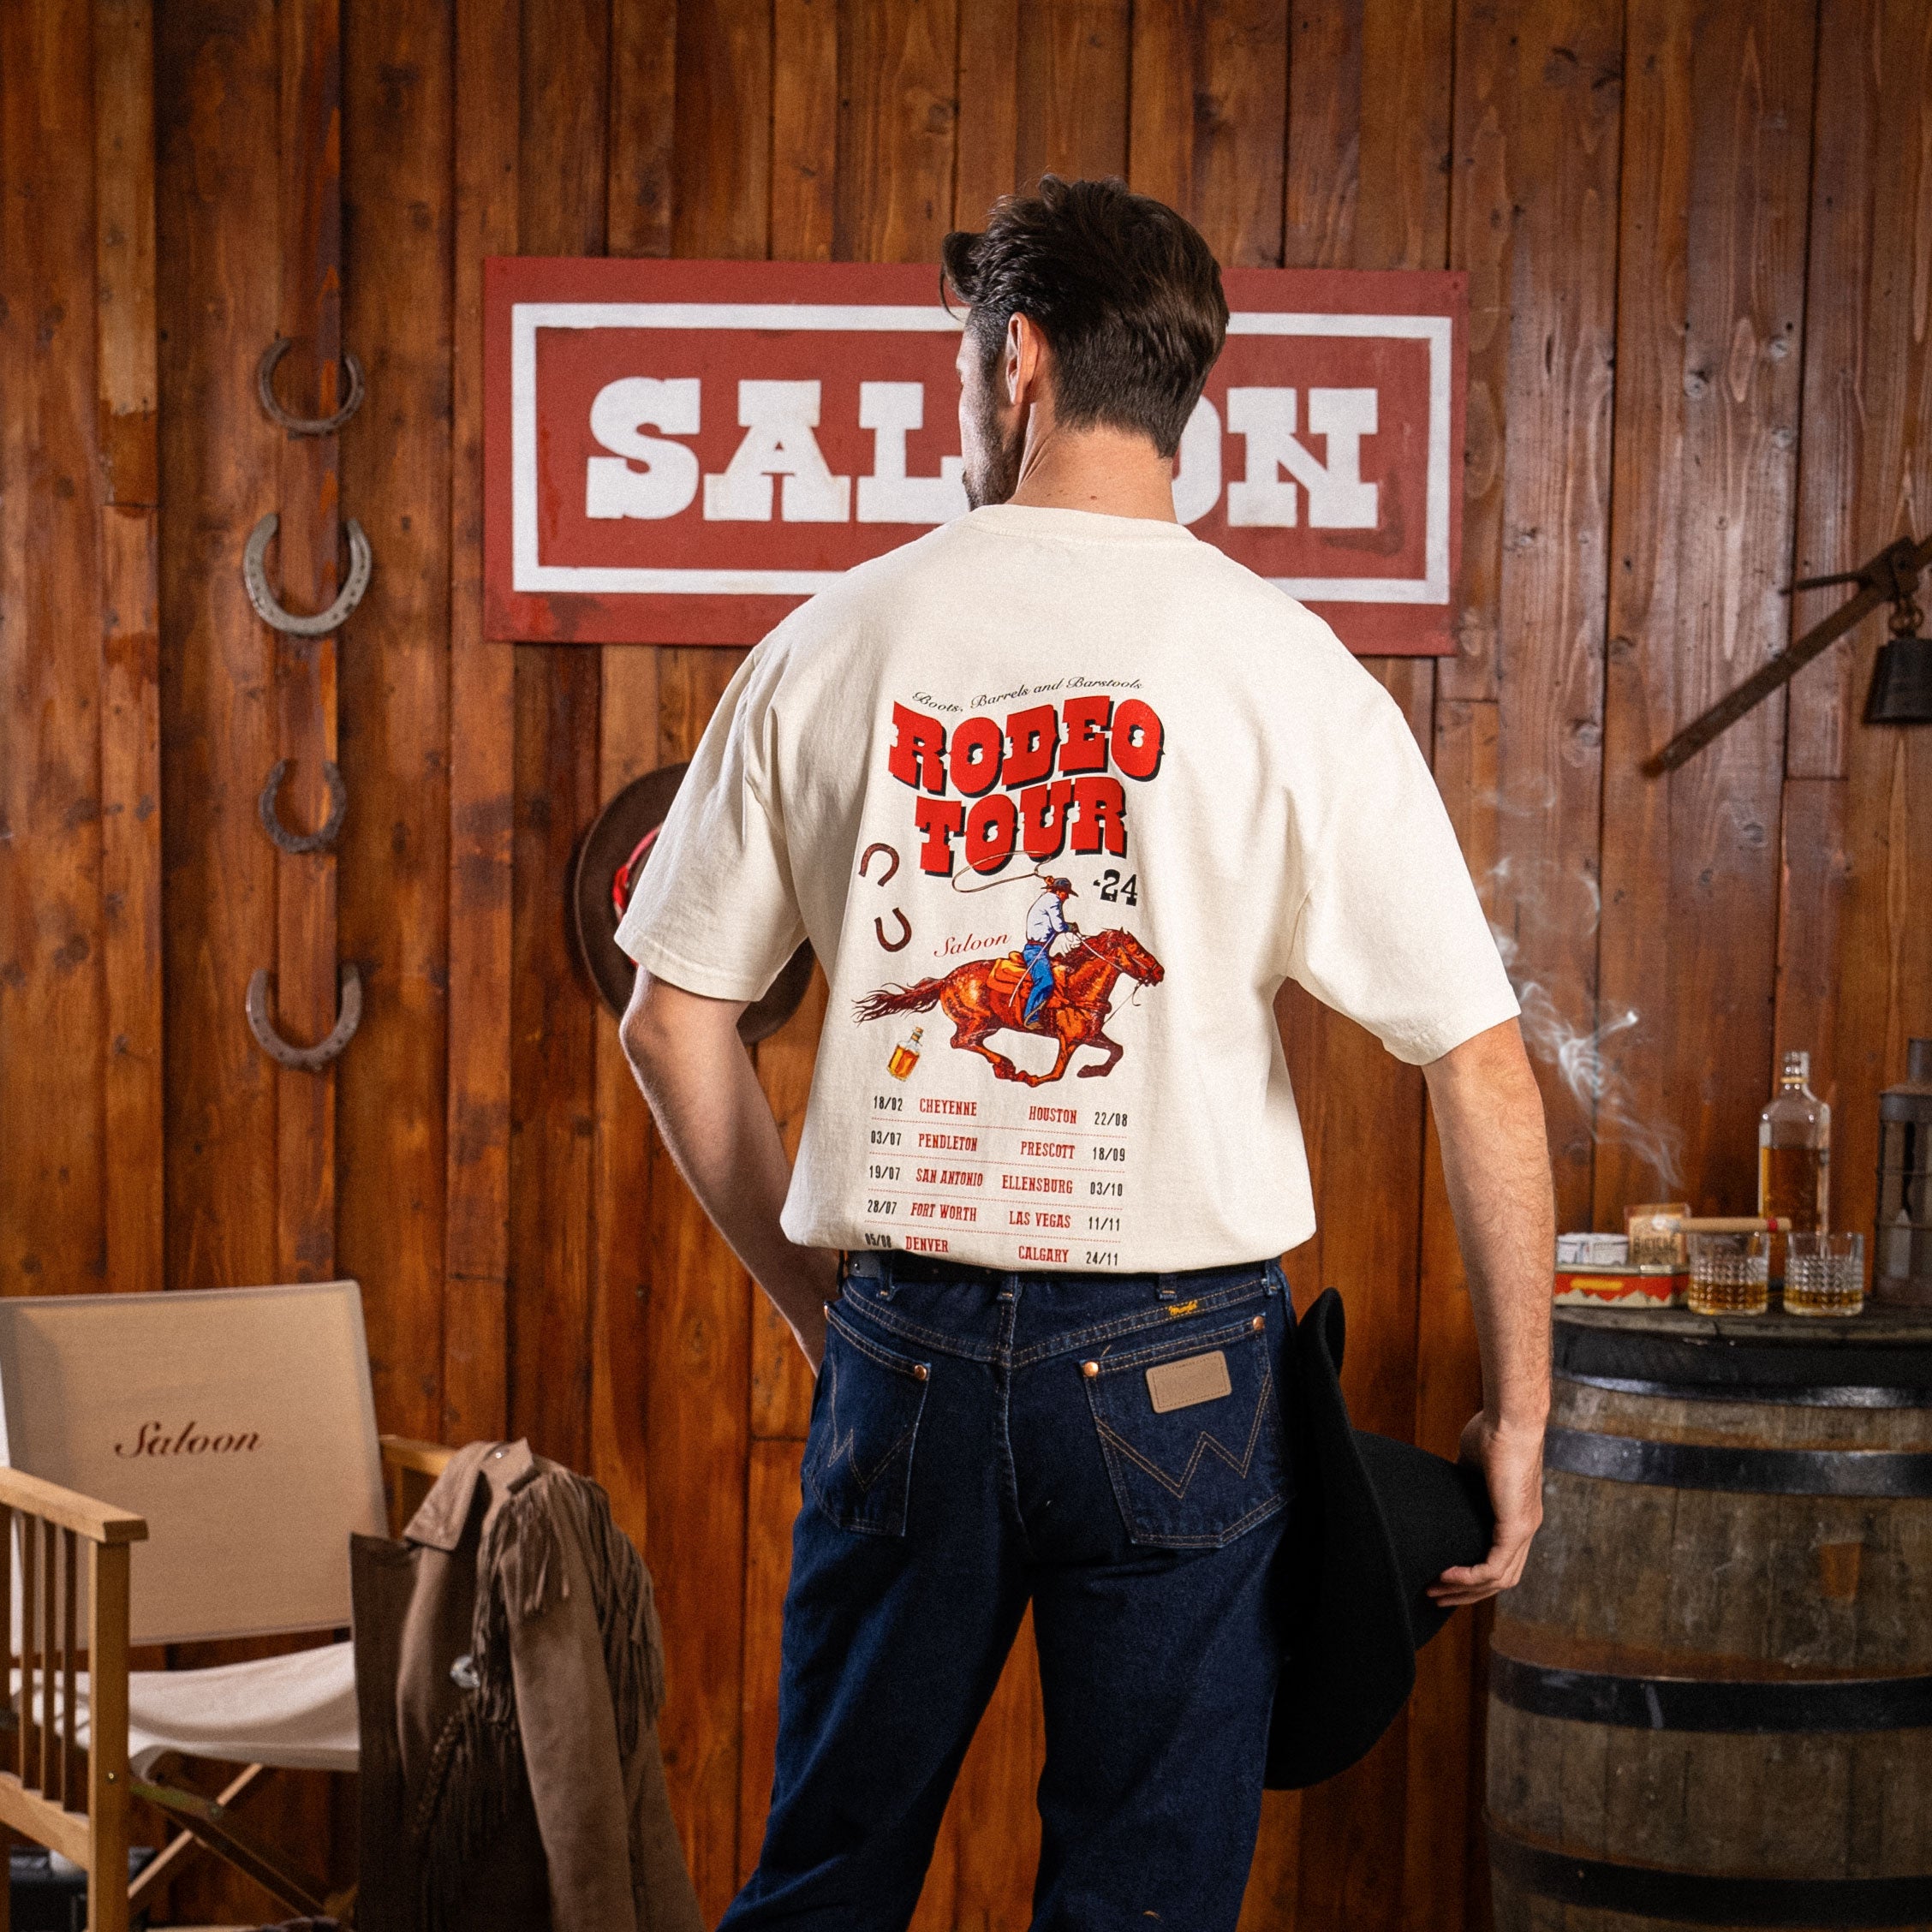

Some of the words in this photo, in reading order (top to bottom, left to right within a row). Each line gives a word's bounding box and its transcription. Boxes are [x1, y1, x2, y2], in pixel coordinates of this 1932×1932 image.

[586, 377, 1378, 528] SALN
[912, 691, 963, 713] Boots,
[970, 684, 1029, 708] Barrels
[1033, 678, 1064, 695] and
[1066, 677, 1144, 690] Barstools
[888, 695, 1166, 798] RODEO
[915, 776, 1127, 878] TOUR
[933, 933, 1011, 957] Saloon
[874, 1096, 903, 1111] 18/02
[920, 1099, 976, 1116] CHEYENNE
[1029, 1106, 1076, 1124] HOUSTON
[1094, 1112, 1127, 1126] 22/08
[871, 1130, 901, 1145] 03/07
[919, 1134, 977, 1151] PENDLETON
[1021, 1142, 1075, 1159] PRESCOTT
[1094, 1148, 1124, 1161] 18/09
[870, 1166, 900, 1180] 19/07
[916, 1168, 937, 1183] SAN
[940, 1171, 983, 1186] ANTONIO
[1002, 1175, 1072, 1194] ELLENSBURG
[1090, 1182, 1122, 1196] 03/10
[868, 1200, 897, 1214] 28/07
[910, 1202, 935, 1217] FORT
[940, 1204, 976, 1221] WORTH
[1010, 1211, 1030, 1225] LAS
[1035, 1213, 1070, 1228] VEGAS
[1089, 1217, 1119, 1231] 11/11
[905, 1236, 949, 1253] DENVER
[1019, 1246, 1069, 1262] CALGARY
[1087, 1251, 1118, 1266] 24/11
[114, 1421, 260, 1458] Saloon
